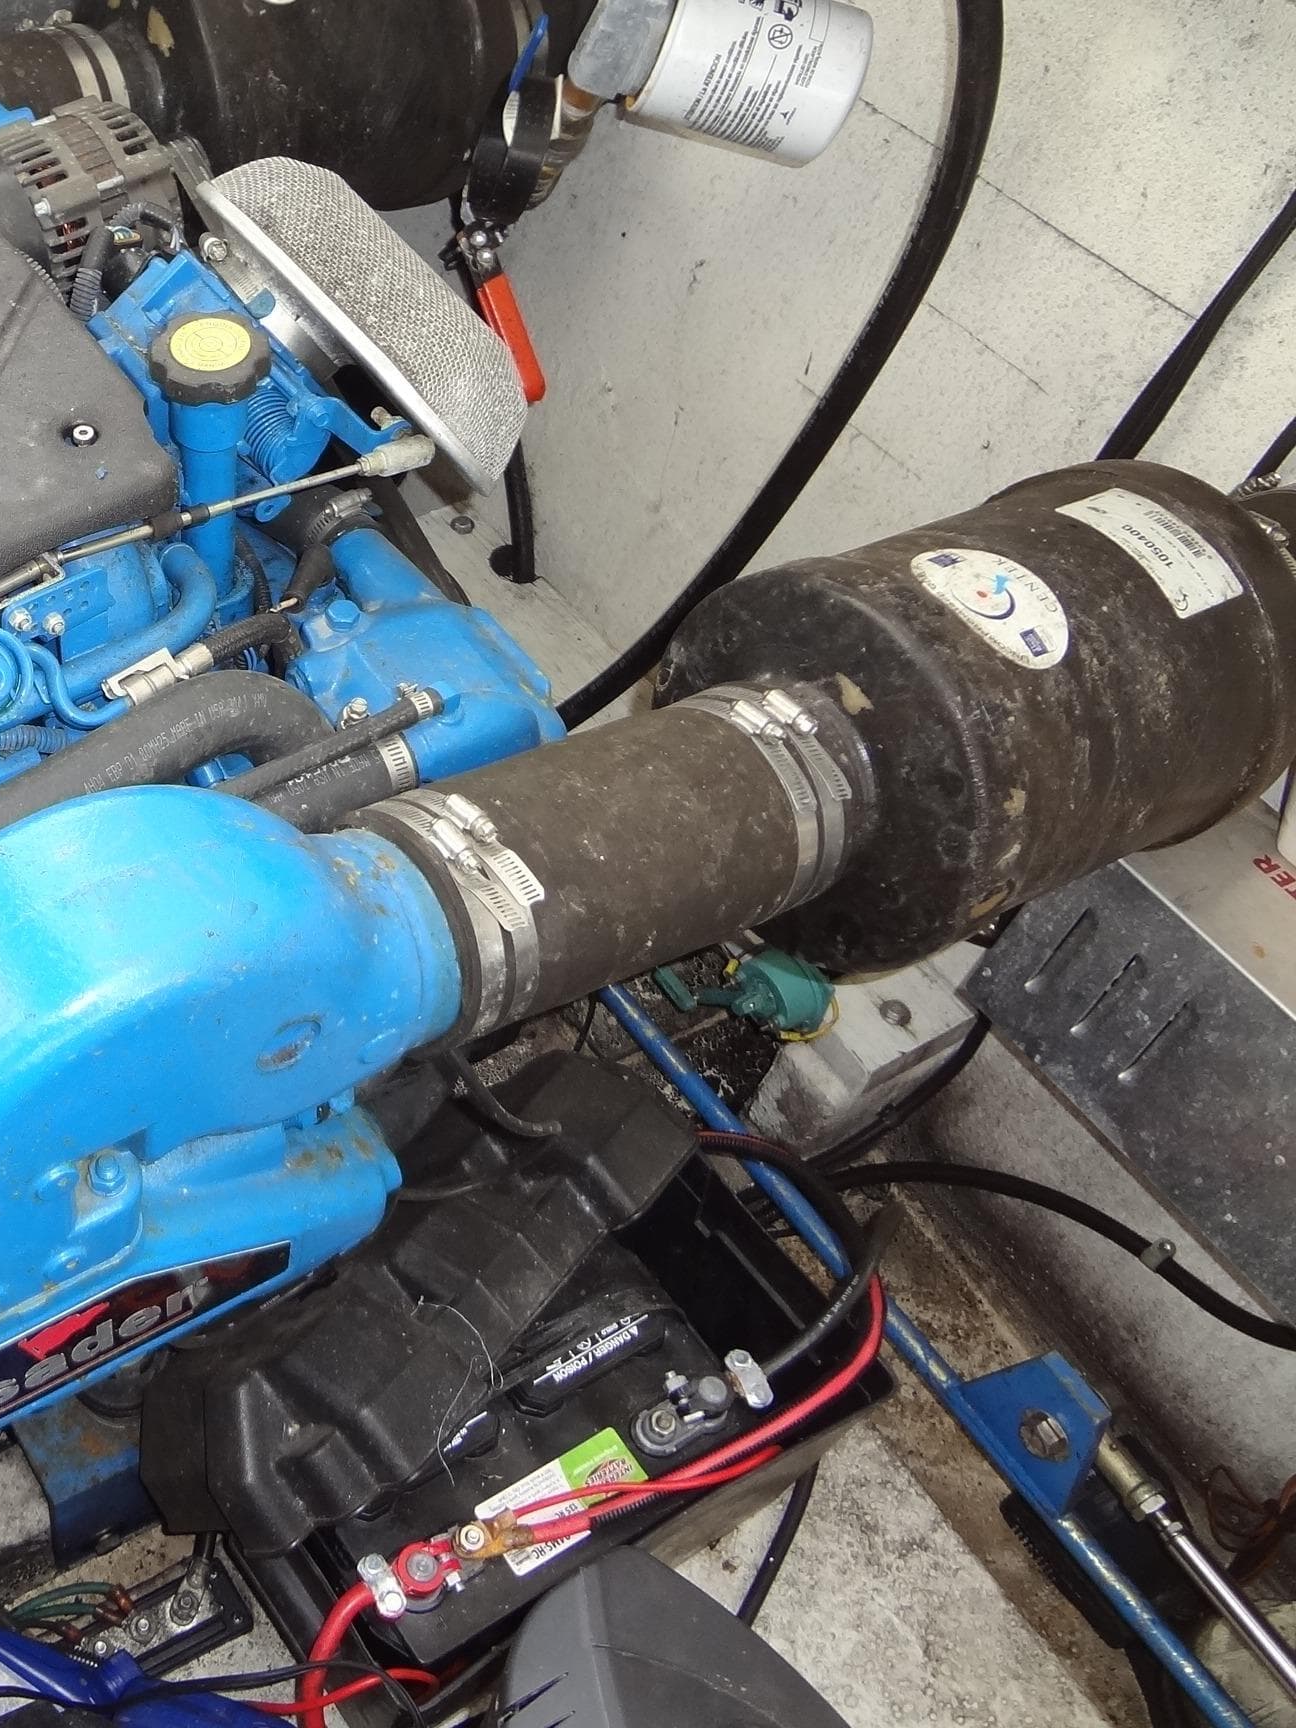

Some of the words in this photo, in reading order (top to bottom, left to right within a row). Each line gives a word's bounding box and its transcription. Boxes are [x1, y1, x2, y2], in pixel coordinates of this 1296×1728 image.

[1121, 522, 1176, 571] 1050400
[992, 555, 1060, 615] CENTEK
[592, 1330, 632, 1360] DANGER
[551, 1356, 589, 1384] POISON
